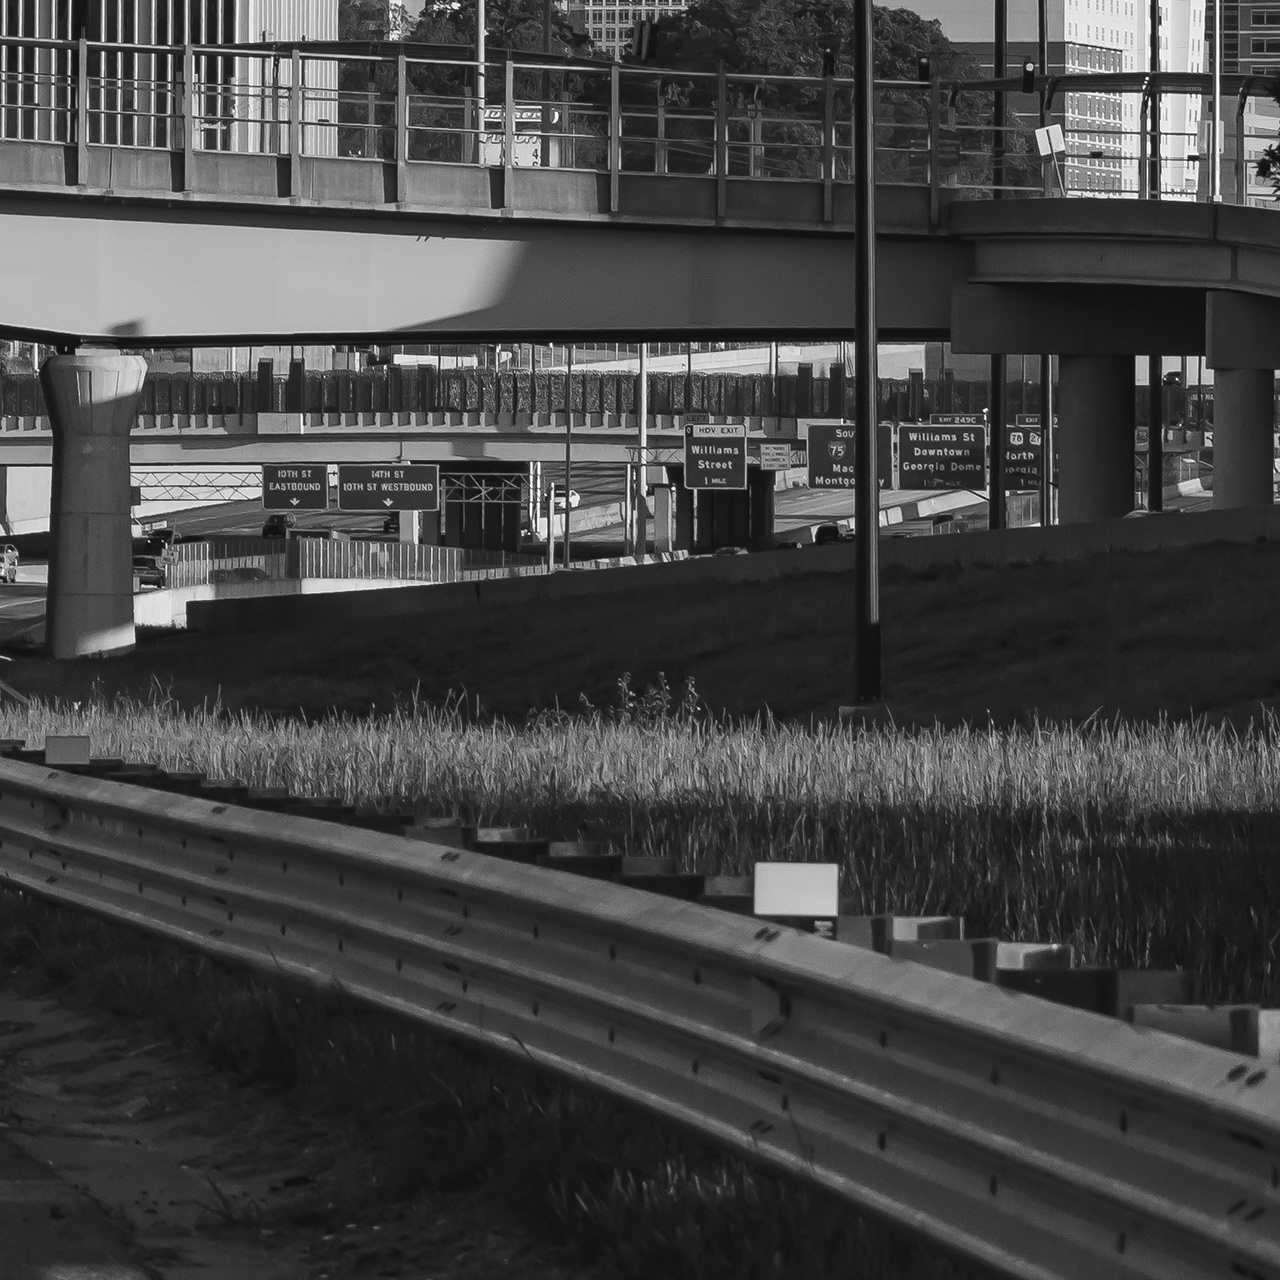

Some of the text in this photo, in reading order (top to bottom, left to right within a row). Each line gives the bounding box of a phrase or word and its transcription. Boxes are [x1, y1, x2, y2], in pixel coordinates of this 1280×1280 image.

[908, 432, 975, 442] Williams St
[691, 445, 739, 455] Williams
[829, 445, 844, 456] 75
[914, 447, 970, 456] Downtown
[698, 460, 733, 469] Street
[903, 462, 981, 473] Georgia Dome
[278, 470, 312, 478] 10TH ST
[371, 470, 404, 478] 14TH ST
[815, 476, 885, 487] Montgoy
[269, 483, 321, 491] EASTBOUND
[343, 483, 433, 491] 10TH ST WESTBOUND
